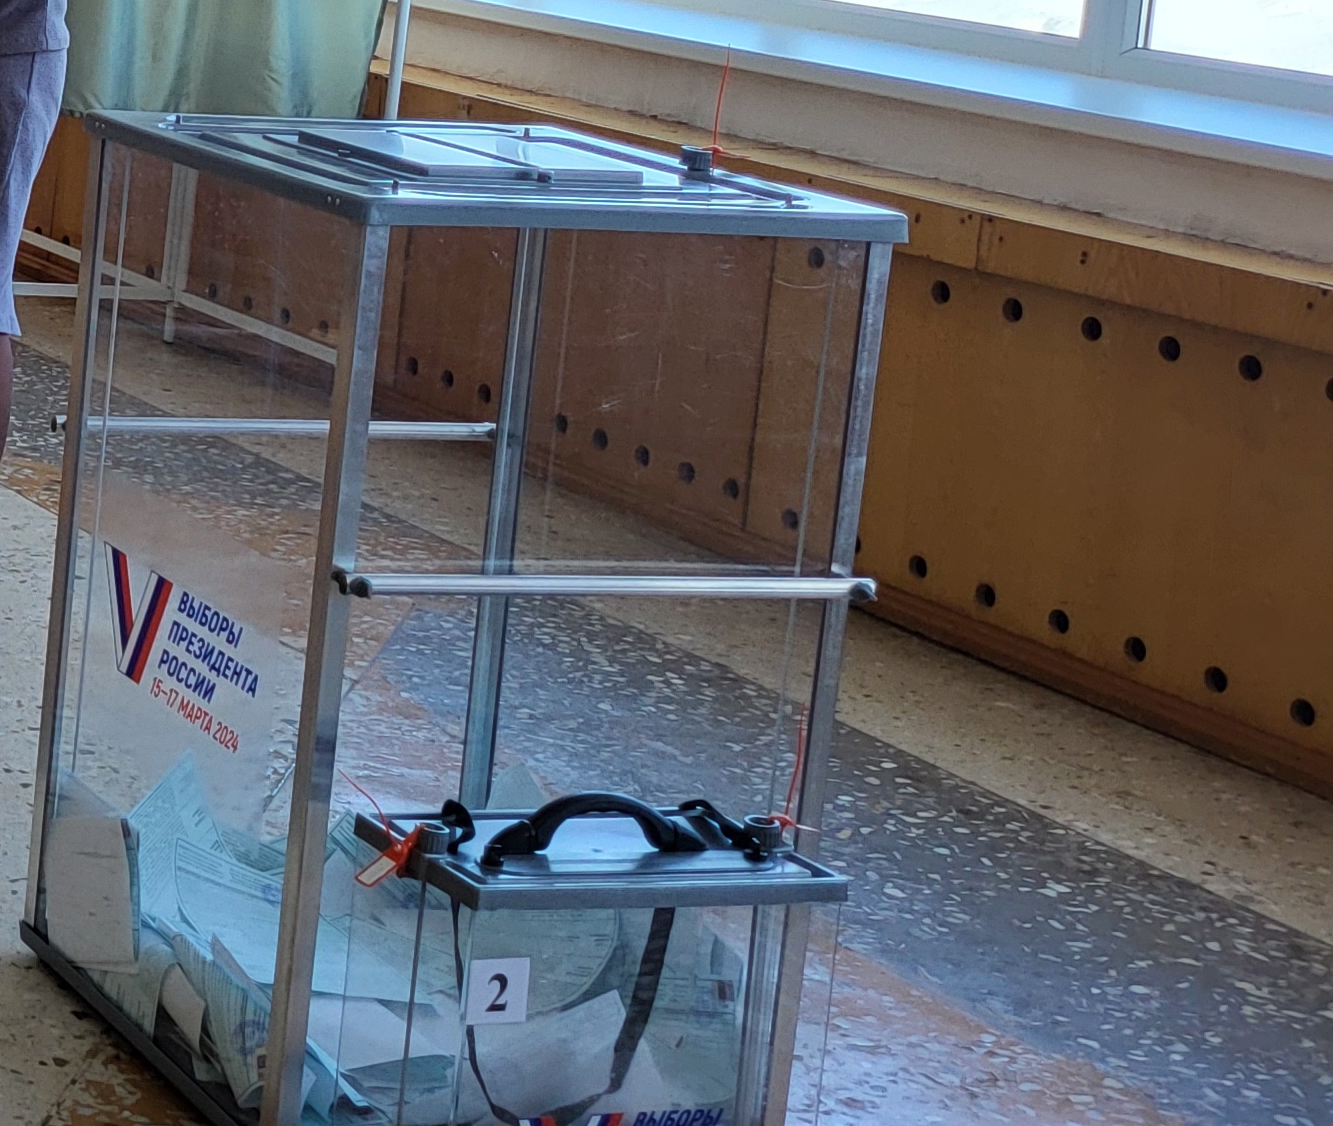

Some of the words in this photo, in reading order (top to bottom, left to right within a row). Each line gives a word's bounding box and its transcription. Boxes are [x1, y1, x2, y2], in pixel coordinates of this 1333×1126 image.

[177, 591, 243, 648] ВЫБОРЫ
[158, 649, 216, 703] РОССИИ
[167, 620, 259, 698] ПРЕЗИДЕНТА
[180, 698, 213, 736] МАРТА
[213, 721, 239, 754] 2024
[485, 973, 509, 1012] 2
[634, 1108, 723, 1126] ВЫБОРЫ
